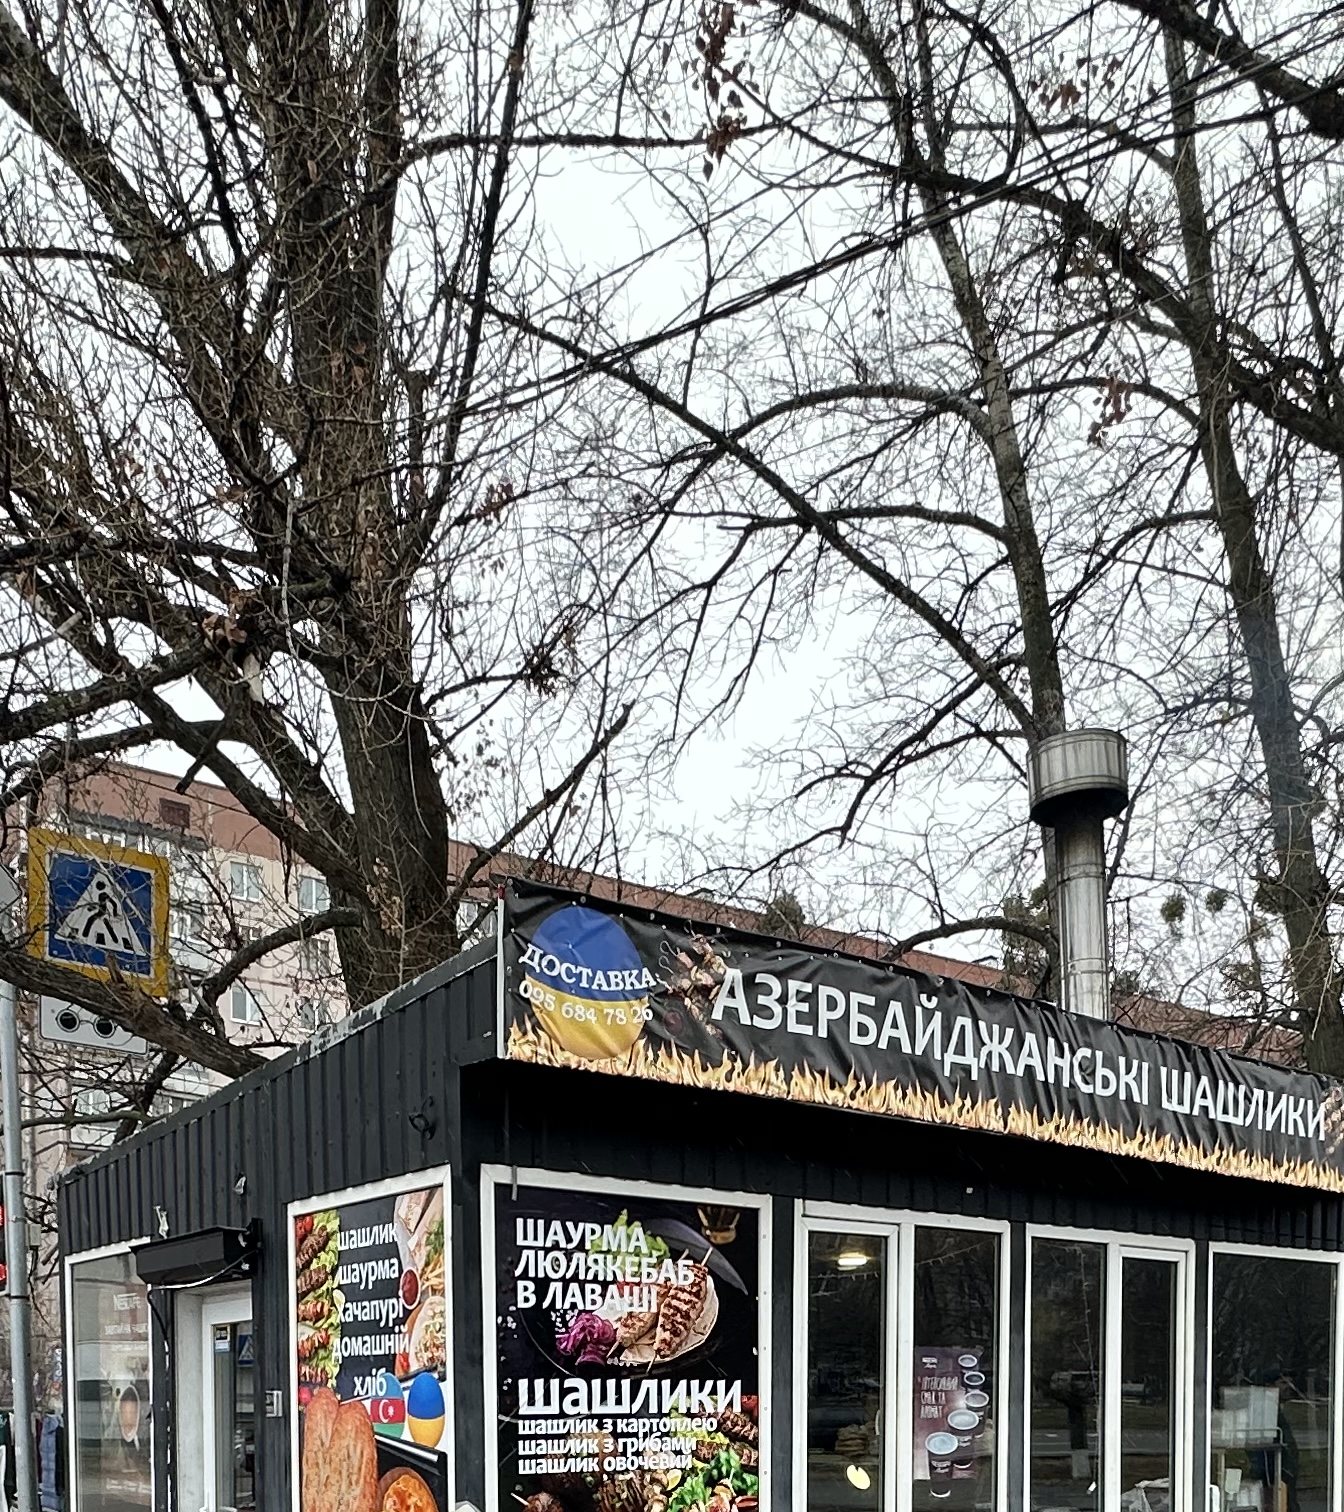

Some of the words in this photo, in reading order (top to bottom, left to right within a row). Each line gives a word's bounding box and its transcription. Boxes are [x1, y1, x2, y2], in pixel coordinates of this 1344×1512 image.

[518, 943, 657, 991] ДОСТАВКА
[518, 980, 556, 1012] 095
[561, 1002, 597, 1025] 684
[603, 1008, 627, 1026] 78
[630, 1003, 654, 1023] 26
[711, 968, 1149, 1106] АЗЕРБАЙДЖАНСЬКІ
[1161, 1066, 1326, 1141] ШАШЛИКИ
[337, 1222, 398, 1251] шашлик
[516, 1218, 648, 1254] ШАУРМА
[338, 1257, 399, 1290] шаурма
[515, 1250, 695, 1286] ЛЮЛЯКЕБАБ
[337, 1290, 404, 1328] хачапурі
[517, 1280, 536, 1309] В
[542, 1281, 658, 1313] ЛАВАШІ
[332, 1325, 409, 1364] домашній
[353, 1368, 387, 1397] хліб
[518, 1418, 599, 1435] шашлик
[603, 1419, 613, 1434] з
[617, 1418, 717, 1438] картоплею
[518, 1439, 599, 1455] шашлик
[603, 1439, 614, 1453] з
[618, 1433, 697, 1457] грибами
[518, 1456, 599, 1475] шашлик
[603, 1449, 693, 1472] овочевий
